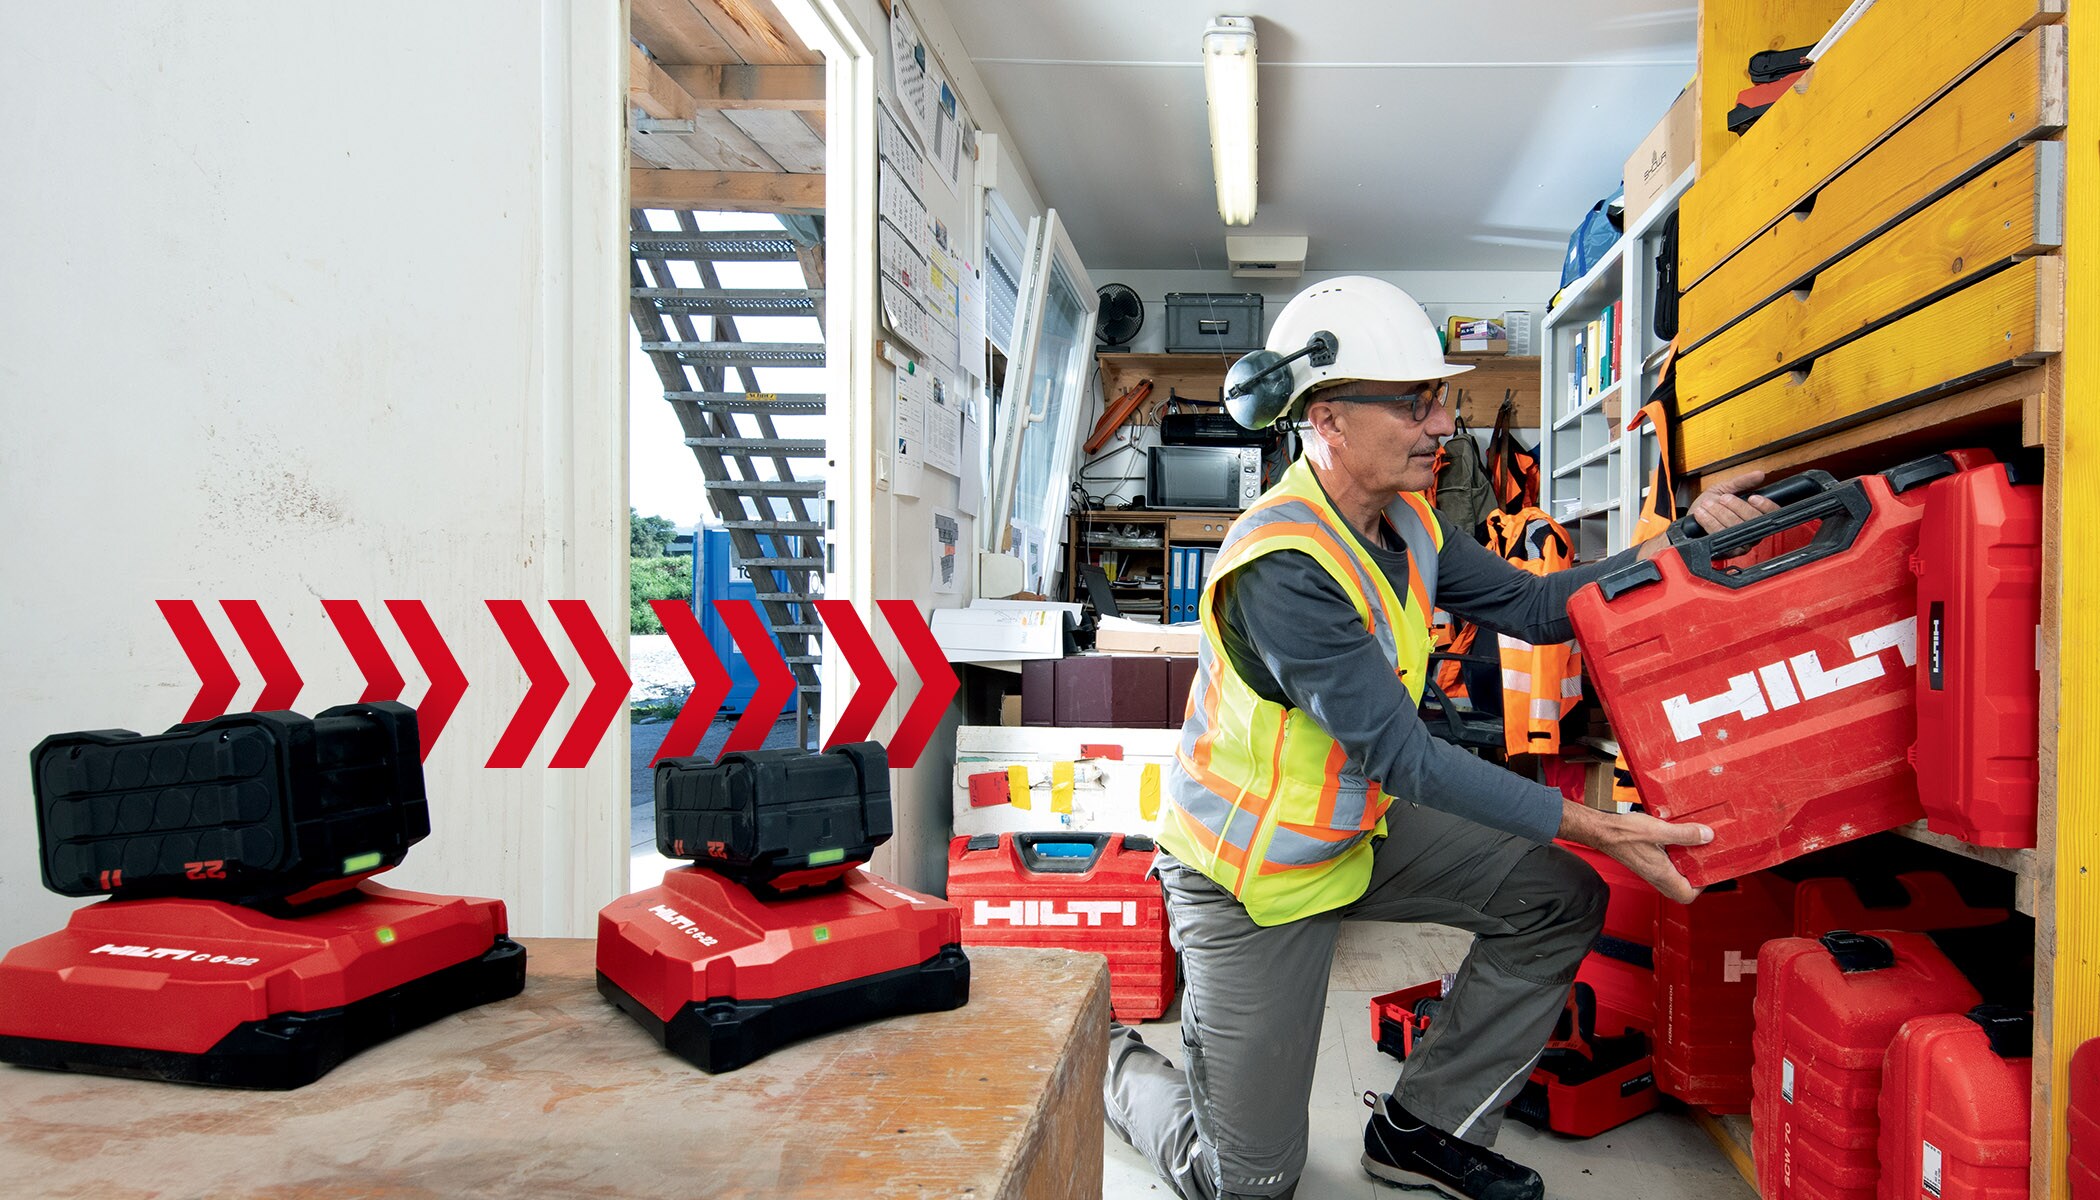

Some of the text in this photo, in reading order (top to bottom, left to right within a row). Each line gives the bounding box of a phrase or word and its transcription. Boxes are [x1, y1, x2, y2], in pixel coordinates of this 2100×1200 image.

[1932, 619, 1940, 673] HILTI
[1661, 616, 1918, 743] HILT
[707, 841, 728, 859] 22
[184, 860, 227, 880] 22
[648, 904, 696, 930] HILTI
[974, 901, 1136, 926] HILTI
[90, 944, 196, 961] HILTI
[190, 953, 211, 962] C
[1784, 1122, 1791, 1145] 70
